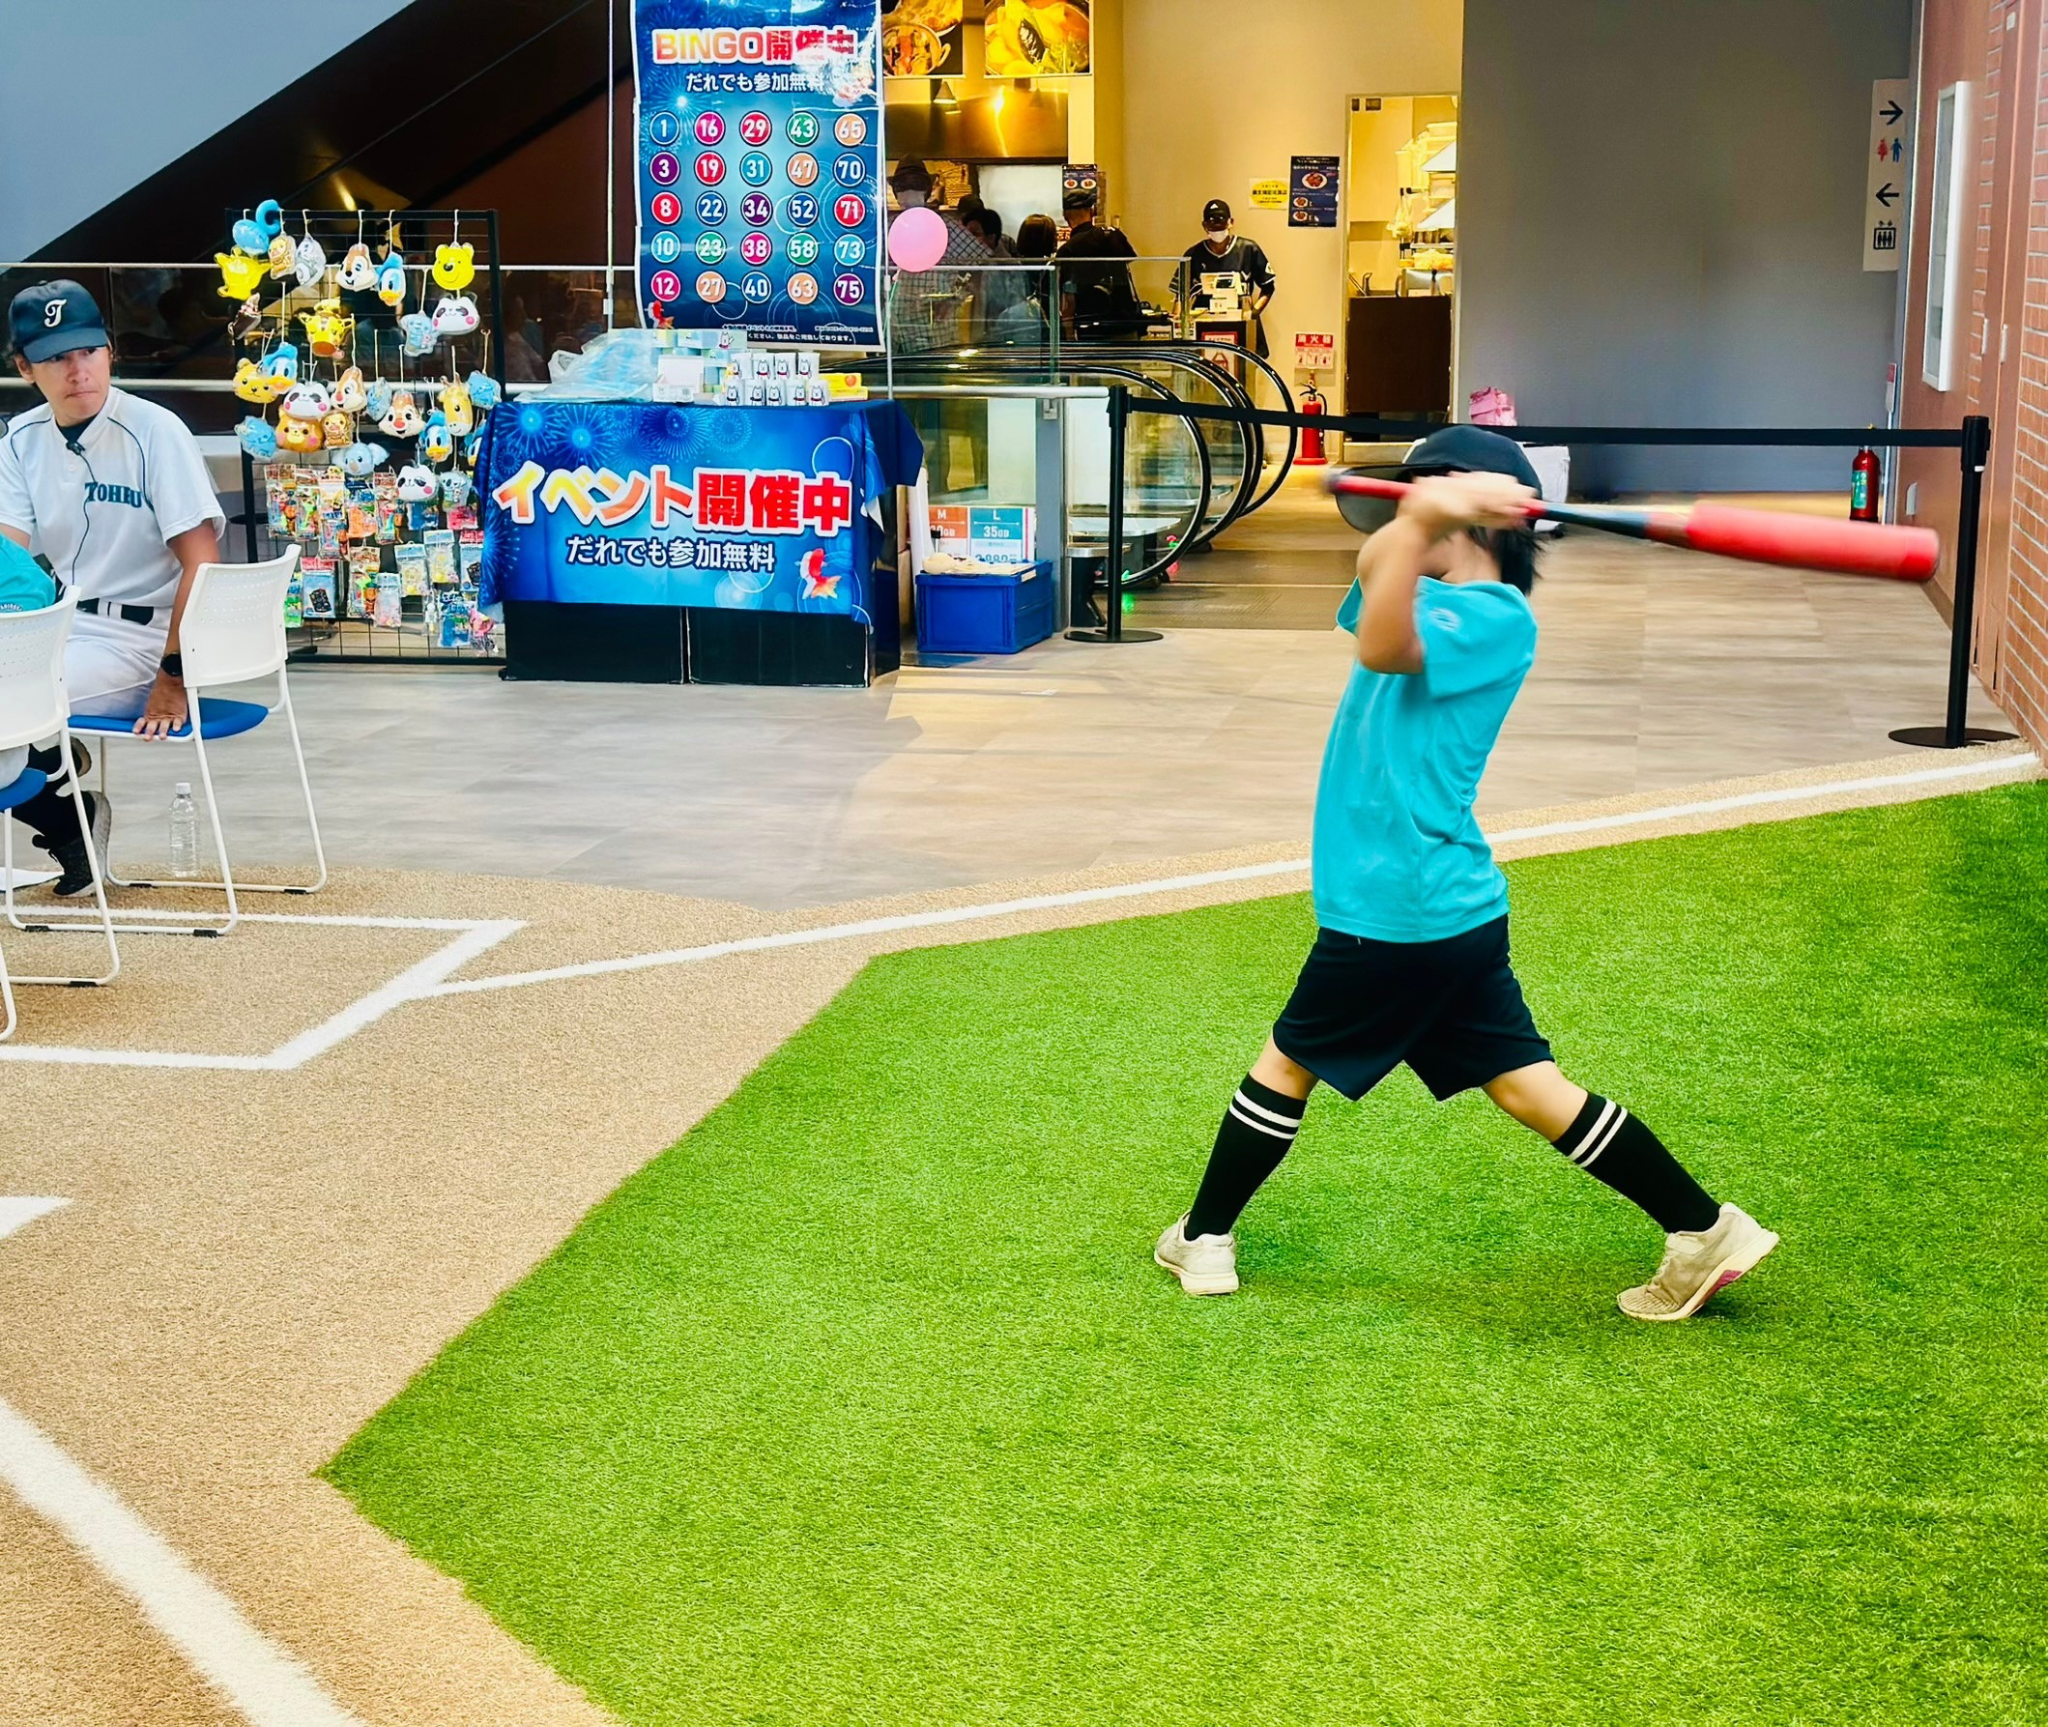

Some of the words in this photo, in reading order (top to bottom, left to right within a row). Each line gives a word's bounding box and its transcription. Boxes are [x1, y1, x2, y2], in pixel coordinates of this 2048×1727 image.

[655, 29, 855, 61] BINGO開催中
[686, 71, 824, 92] だれでも参加無料
[660, 119, 667, 137] 1
[700, 118, 718, 137] 16
[744, 119, 767, 137] 29
[791, 119, 814, 138] 43
[840, 121, 861, 139] 65
[658, 159, 669, 178] 3
[701, 159, 719, 178] 19
[746, 159, 764, 178] 31
[791, 160, 813, 178] 47
[838, 161, 860, 179] 70
[660, 198, 672, 217] 8
[701, 198, 723, 217] 22
[744, 199, 768, 217] 34
[792, 200, 814, 218] 52
[840, 201, 860, 219] 71
[656, 238, 674, 256] 10
[700, 238, 722, 257] 23
[744, 239, 767, 257] 38
[791, 240, 814, 258] 58
[838, 241, 860, 259] 73
[655, 277, 675, 295] 12
[700, 278, 722, 296] 27
[744, 279, 768, 297] 40
[791, 280, 813, 297] 63
[837, 281, 860, 299] 75
[496, 464, 852, 534] イベント開催中
[937, 509, 947, 520] M
[993, 509, 1001, 520] L
[983, 525, 1010, 538] 35GB
[567, 536, 775, 571] だれでも参加無料
